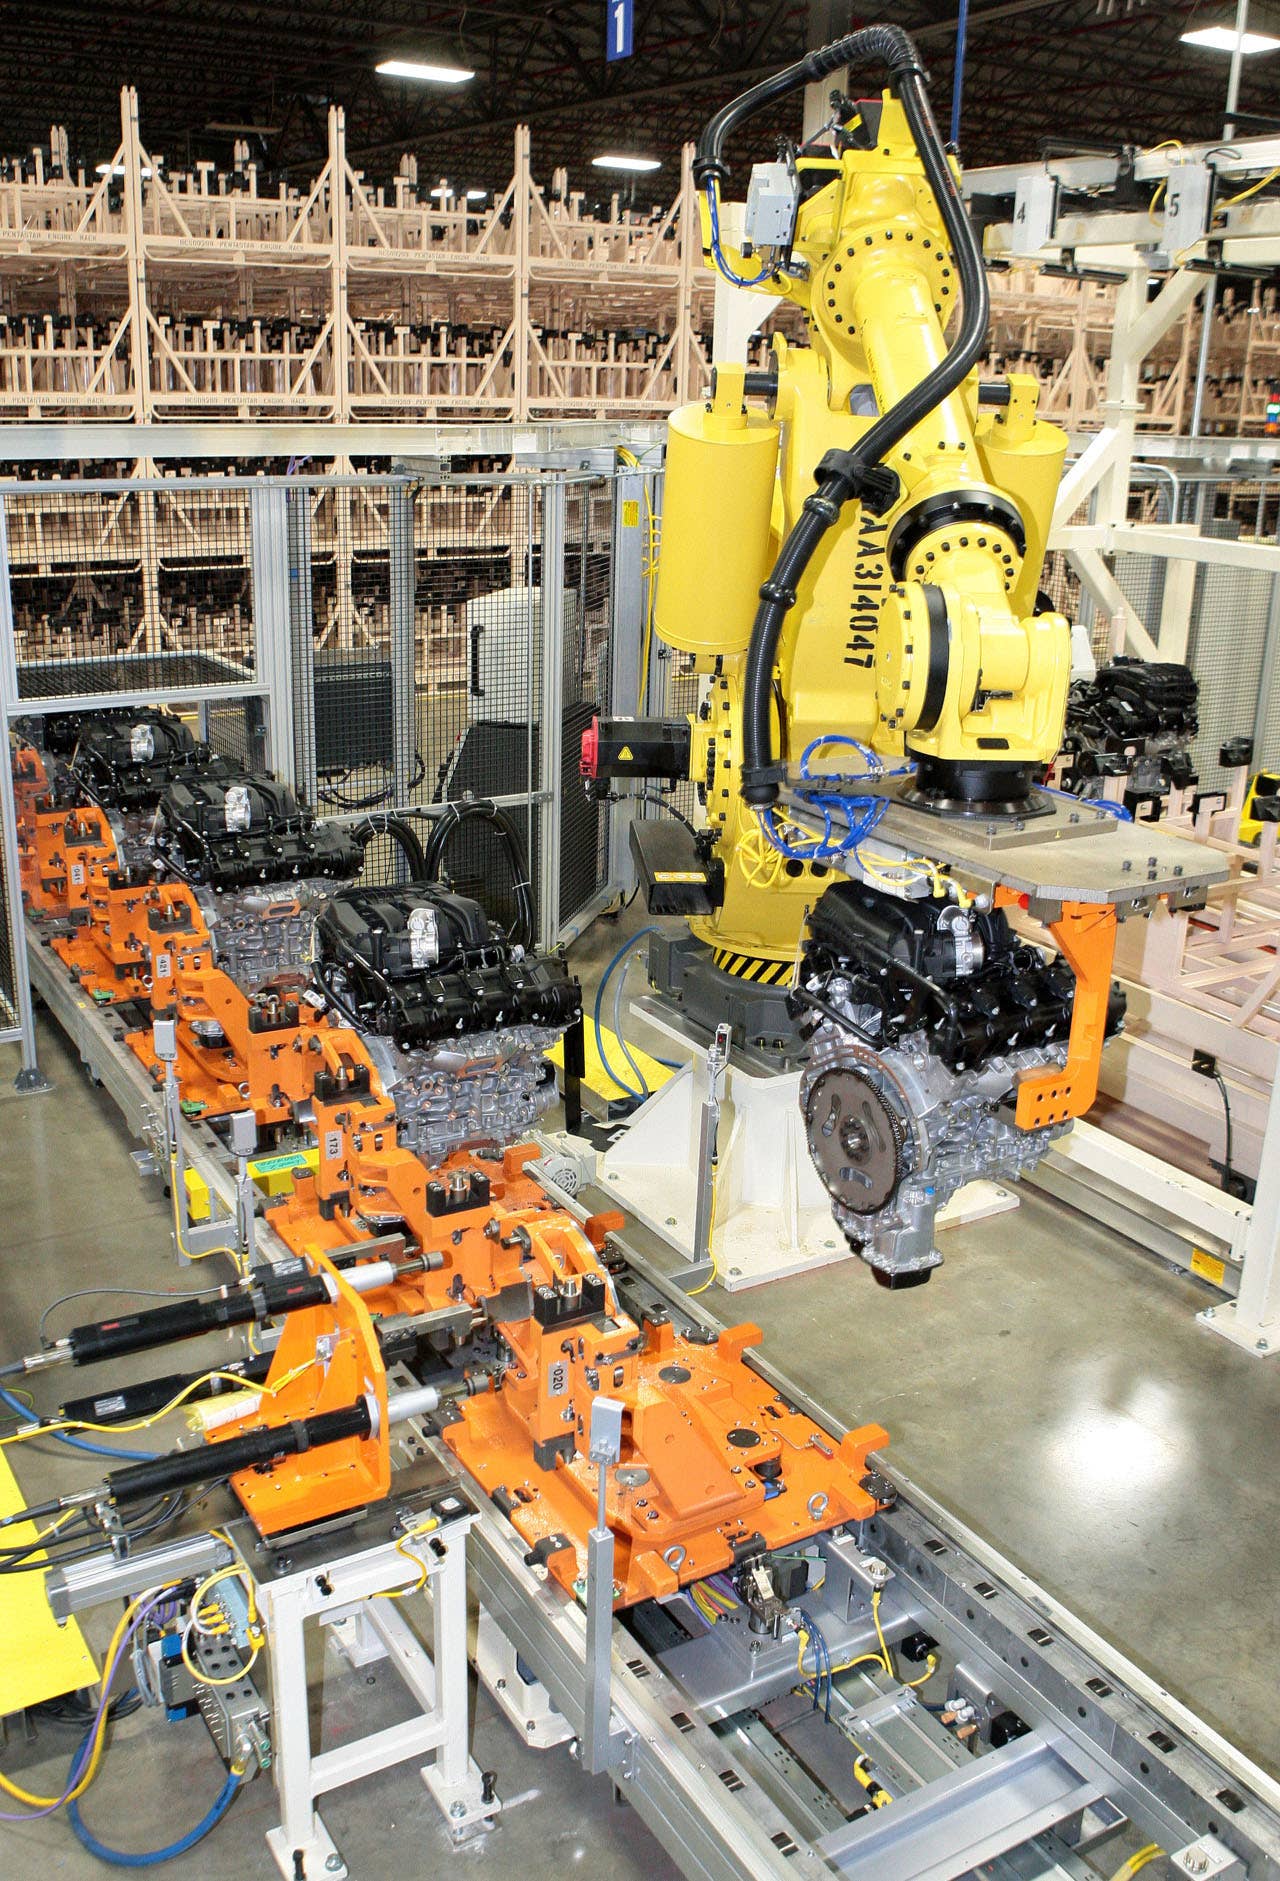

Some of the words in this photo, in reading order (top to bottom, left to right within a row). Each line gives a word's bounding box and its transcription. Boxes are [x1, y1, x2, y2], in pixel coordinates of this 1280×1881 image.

[614, 2, 624, 53] 1
[1016, 202, 1026, 224] 4
[1169, 192, 1180, 217] 5
[843, 516, 888, 669] AA314047
[329, 1137, 339, 1155] 173
[552, 1368, 564, 1390] 020
